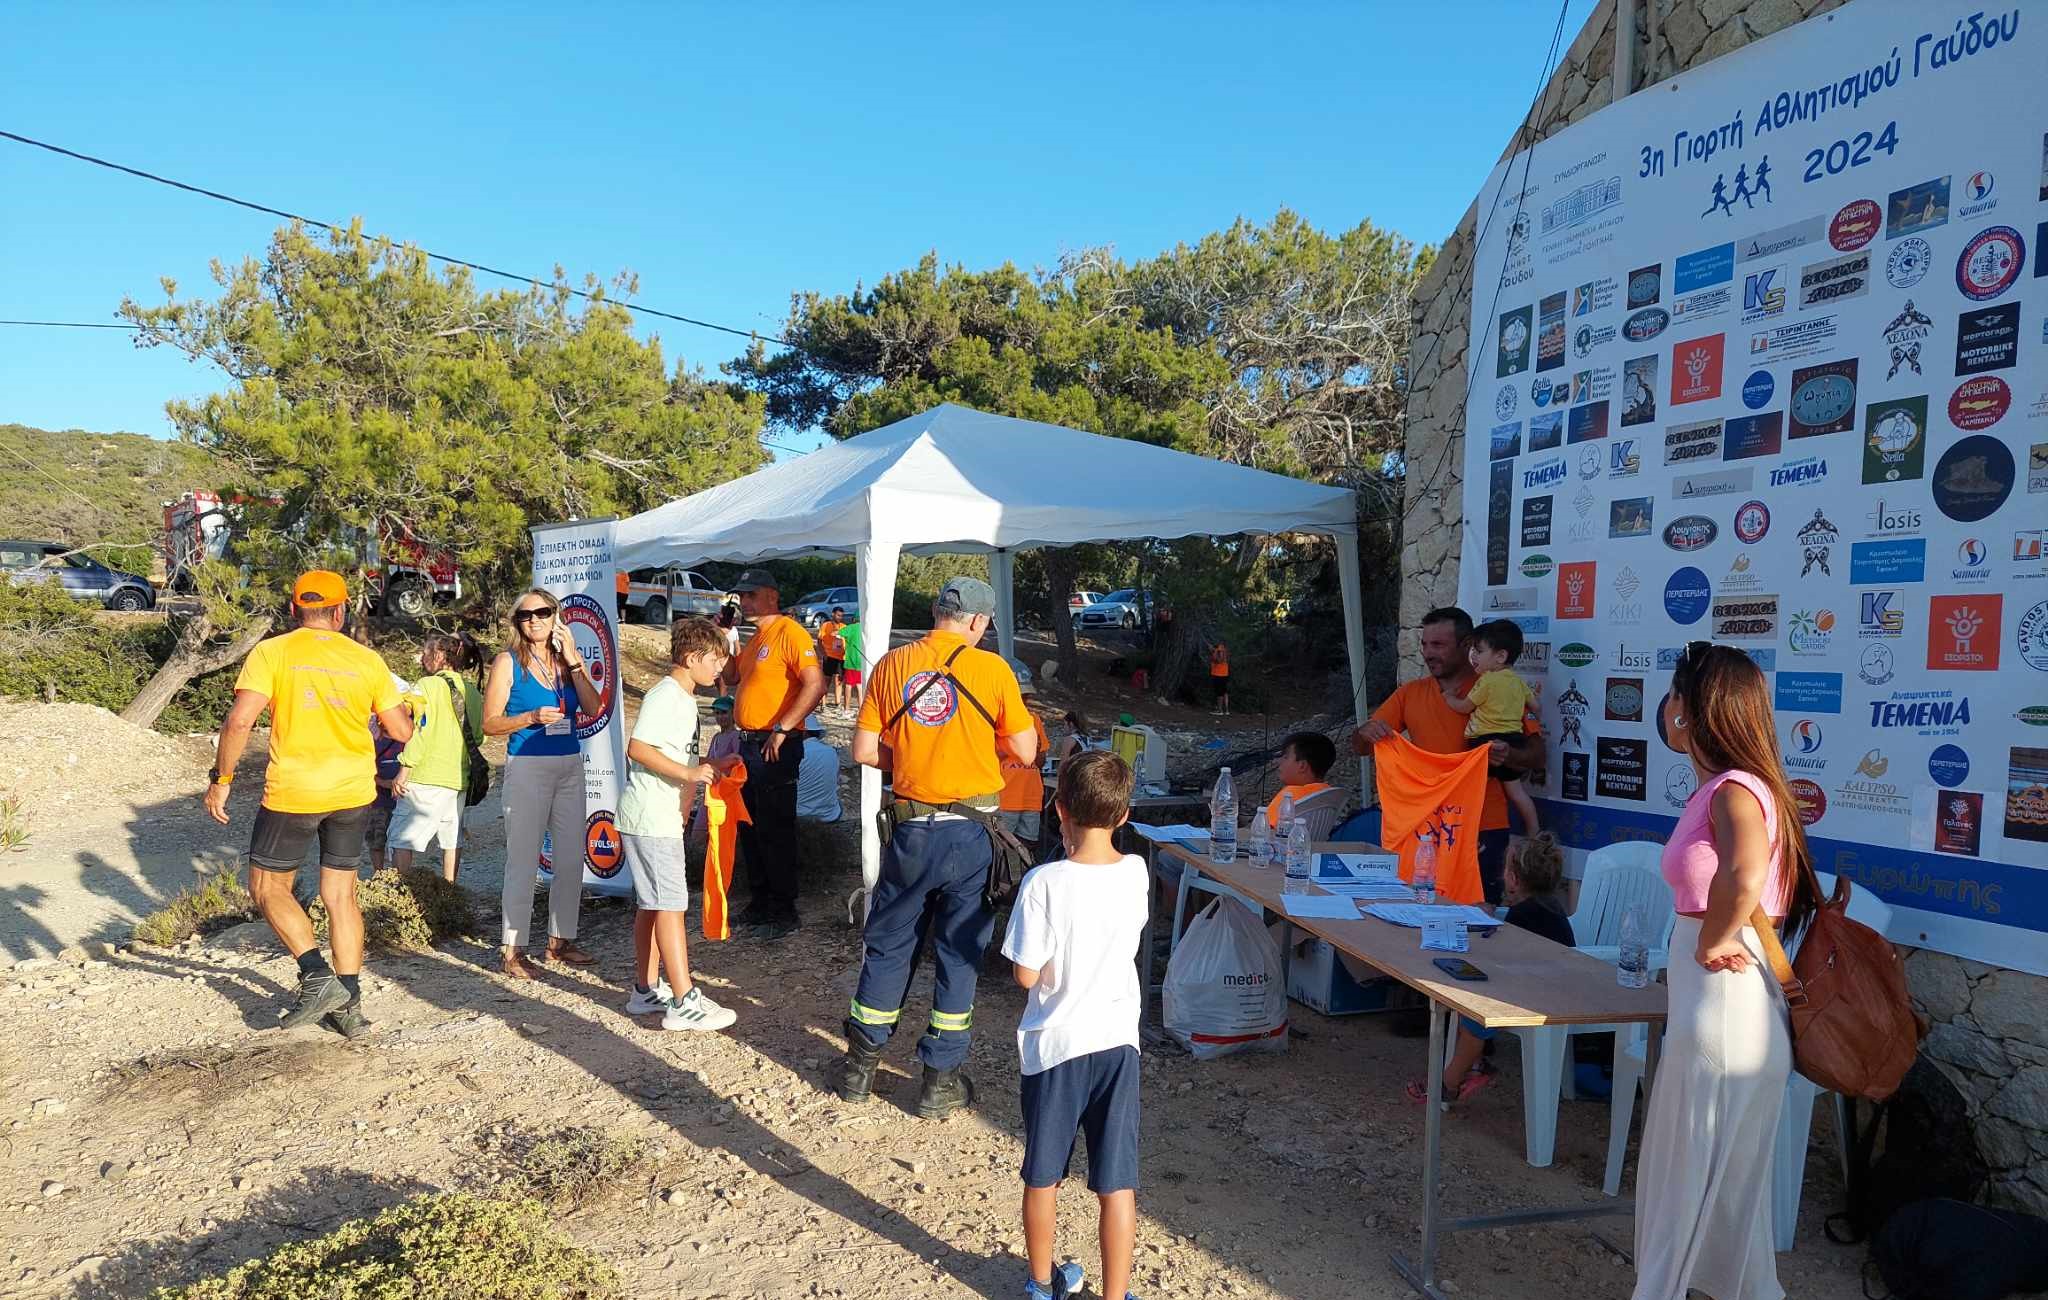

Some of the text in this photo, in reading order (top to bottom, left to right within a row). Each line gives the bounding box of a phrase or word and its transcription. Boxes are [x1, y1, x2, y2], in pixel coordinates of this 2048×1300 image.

[1639, 9, 2019, 178] 3η Γιορτή Αθλητισμού Γαύδου
[1803, 121, 1898, 183] 2024
[1960, 342, 2013, 359] MOTORBIKE
[1967, 352, 2006, 366] RENTALS
[1770, 459, 1827, 487] TEMENIA
[540, 537, 606, 554] ΕΠΙΛΕΚΤΗ ΟΜΑΔΑ
[536, 552, 612, 570] ΕΙΔΙΚΩΝ ΑΠΟΣΤΟΛΩΝ
[544, 570, 603, 585] ΔΗΜΟΥ ΧΑΝΙΩΝ
[1951, 568, 1992, 580] Samaria
[2020, 606, 2043, 653] GAVDOS
[577, 646, 600, 659] CUE
[1869, 696, 1971, 728] TEMENIA
[576, 713, 609, 739] OTECTION
[1784, 755, 1828, 769] Samaria
[1843, 780, 1897, 795] KALYPSO
[1835, 850, 2002, 915] Ευρώπης
